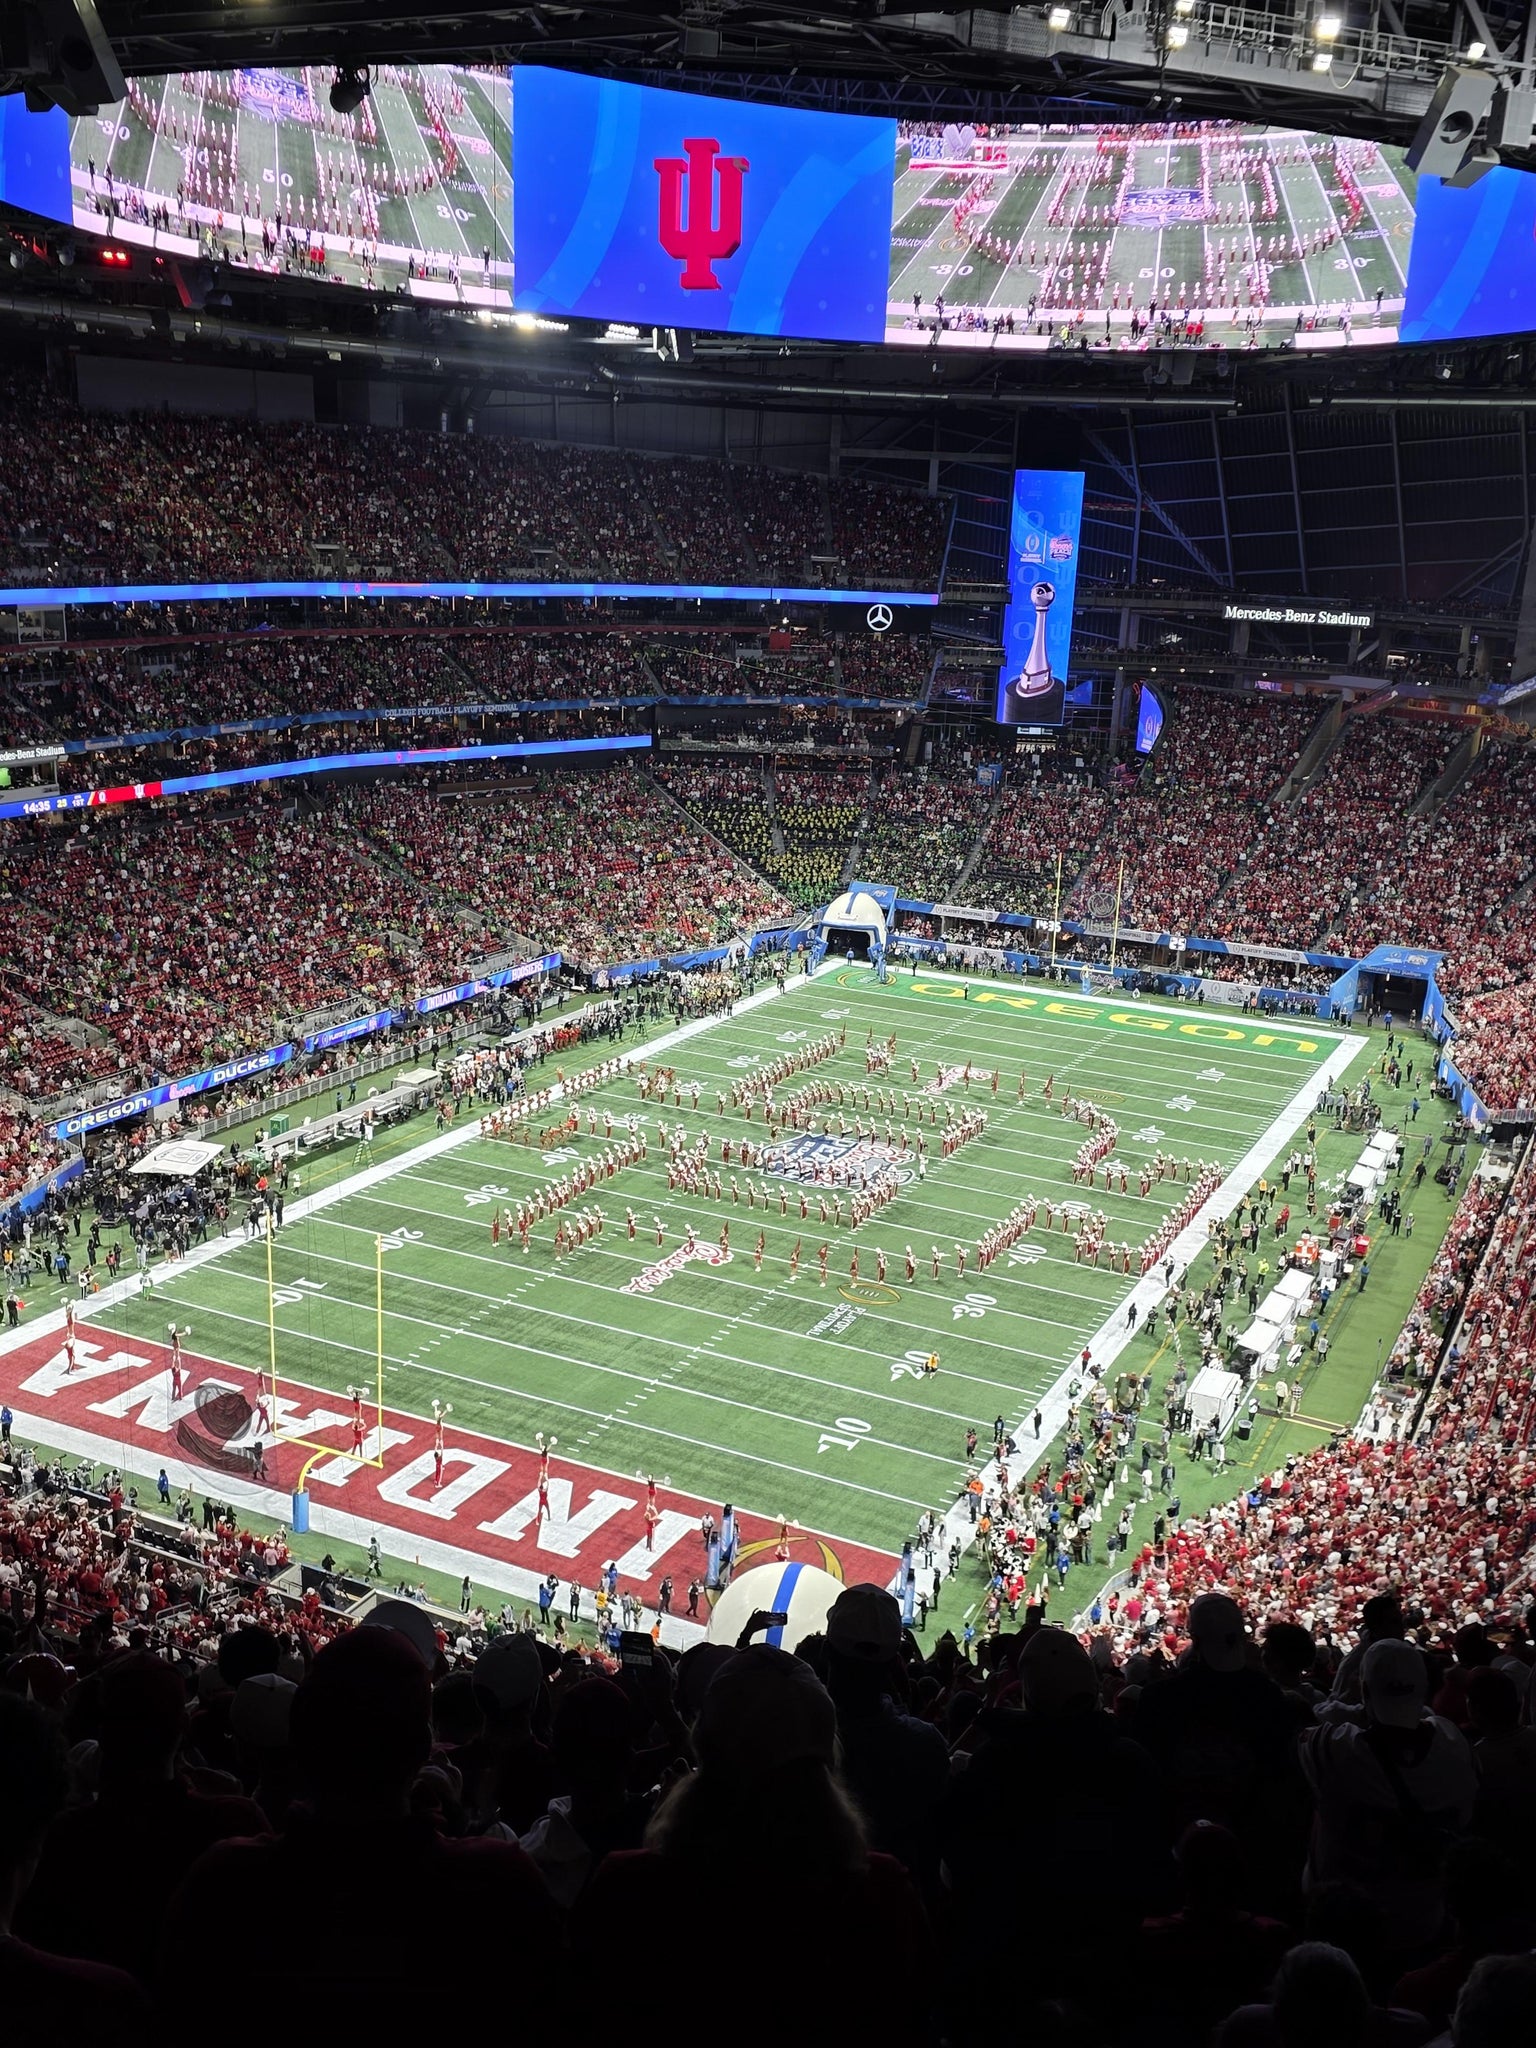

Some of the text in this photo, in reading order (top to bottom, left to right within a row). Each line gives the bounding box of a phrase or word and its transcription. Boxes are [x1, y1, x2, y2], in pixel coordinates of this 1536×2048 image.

[262, 167, 294, 187] 50
[437, 205, 469, 221] 30
[935, 265, 974, 276] 30
[1138, 267, 1176, 279] 50
[1225, 605, 1371, 626] Mercedes-Benz Stadium
[384, 703, 519, 717] COLLEGE FOOTBALL PLAYOFF SEMIFINAL
[36, 746, 65, 758] Stadium
[23, 800, 51, 814] 14:35
[943, 908, 961, 916] PLAYOFF
[1241, 946, 1261, 955] PLAYOFF
[511, 960, 544, 981] HOOSIERS
[427, 988, 458, 1010] INDIANA
[910, 983, 1319, 1053] OREGON
[213, 1054, 270, 1083] DUCKS
[66, 1097, 149, 1134] OREGON
[464, 1184, 509, 1204] 30
[375, 1226, 424, 1250] 20
[1012, 1243, 1047, 1264] 40
[272, 1276, 328, 1302] 10
[953, 1293, 997, 1318] 30
[806, 1303, 852, 1337] SEMIFINAL
[829, 1306, 867, 1335] PLAYOFF
[891, 1350, 937, 1380] 20
[819, 1417, 872, 1451] 10
[18, 1337, 702, 1582] INDIANA
